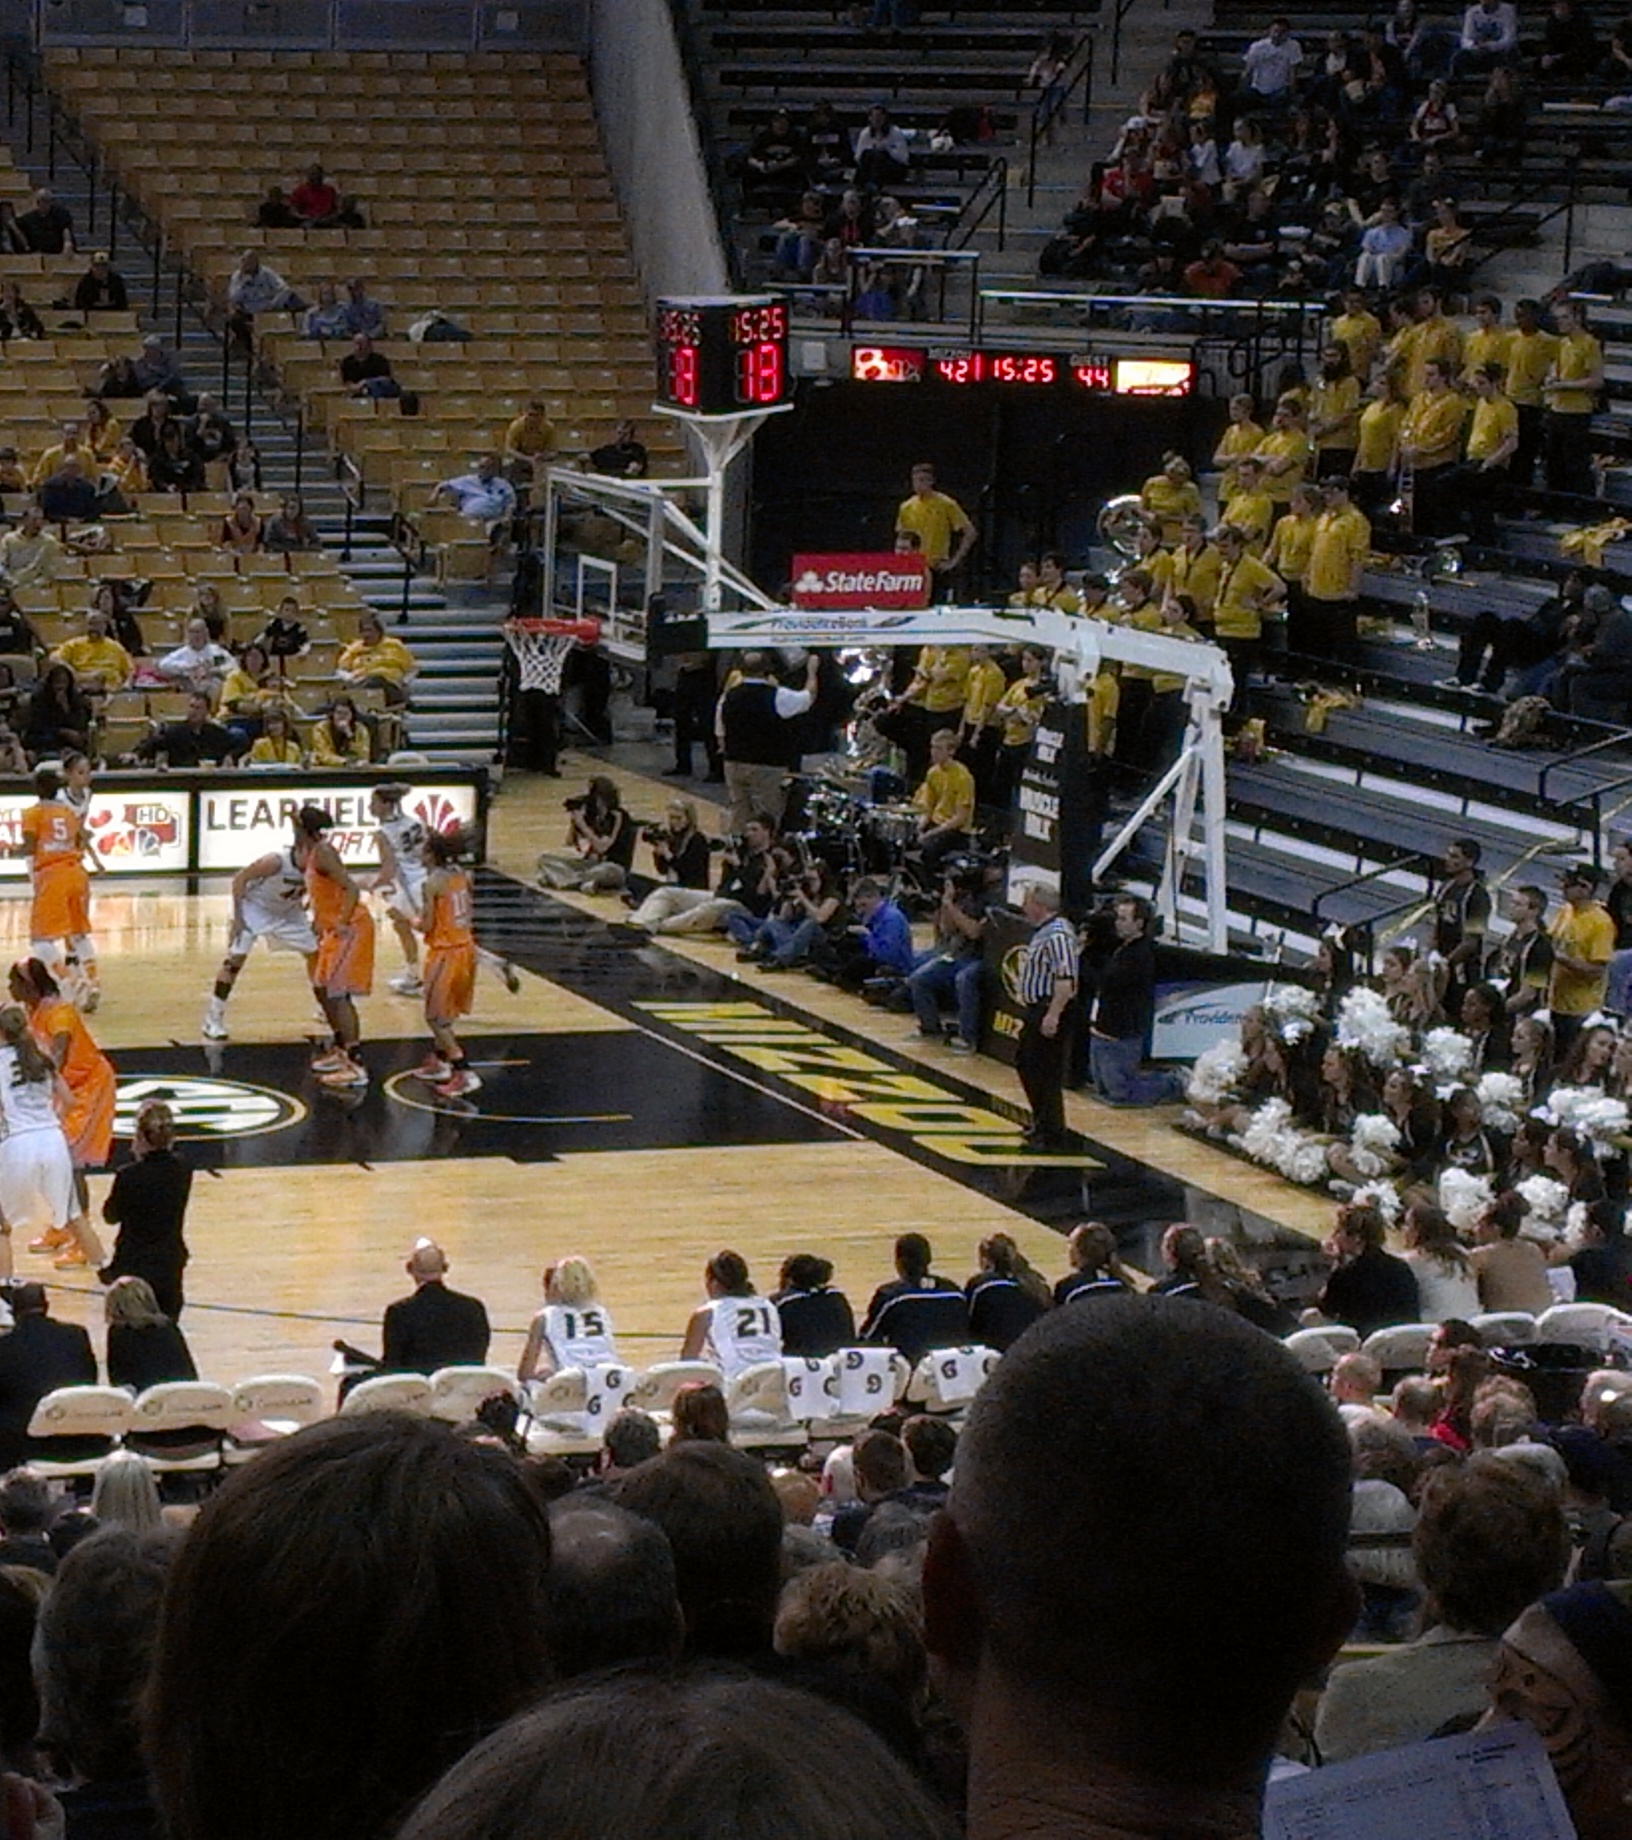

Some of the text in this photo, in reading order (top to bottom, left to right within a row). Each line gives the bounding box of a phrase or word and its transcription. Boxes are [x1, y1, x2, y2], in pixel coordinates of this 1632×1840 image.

[732, 307, 784, 343] 15:25
[939, 361, 968, 383] 42
[992, 357, 1054, 382] 15:25
[1078, 368, 1110, 388] 44
[52, 818, 68, 841] 5
[564, 1311, 604, 1339] 15
[737, 1307, 769, 1338] 21
